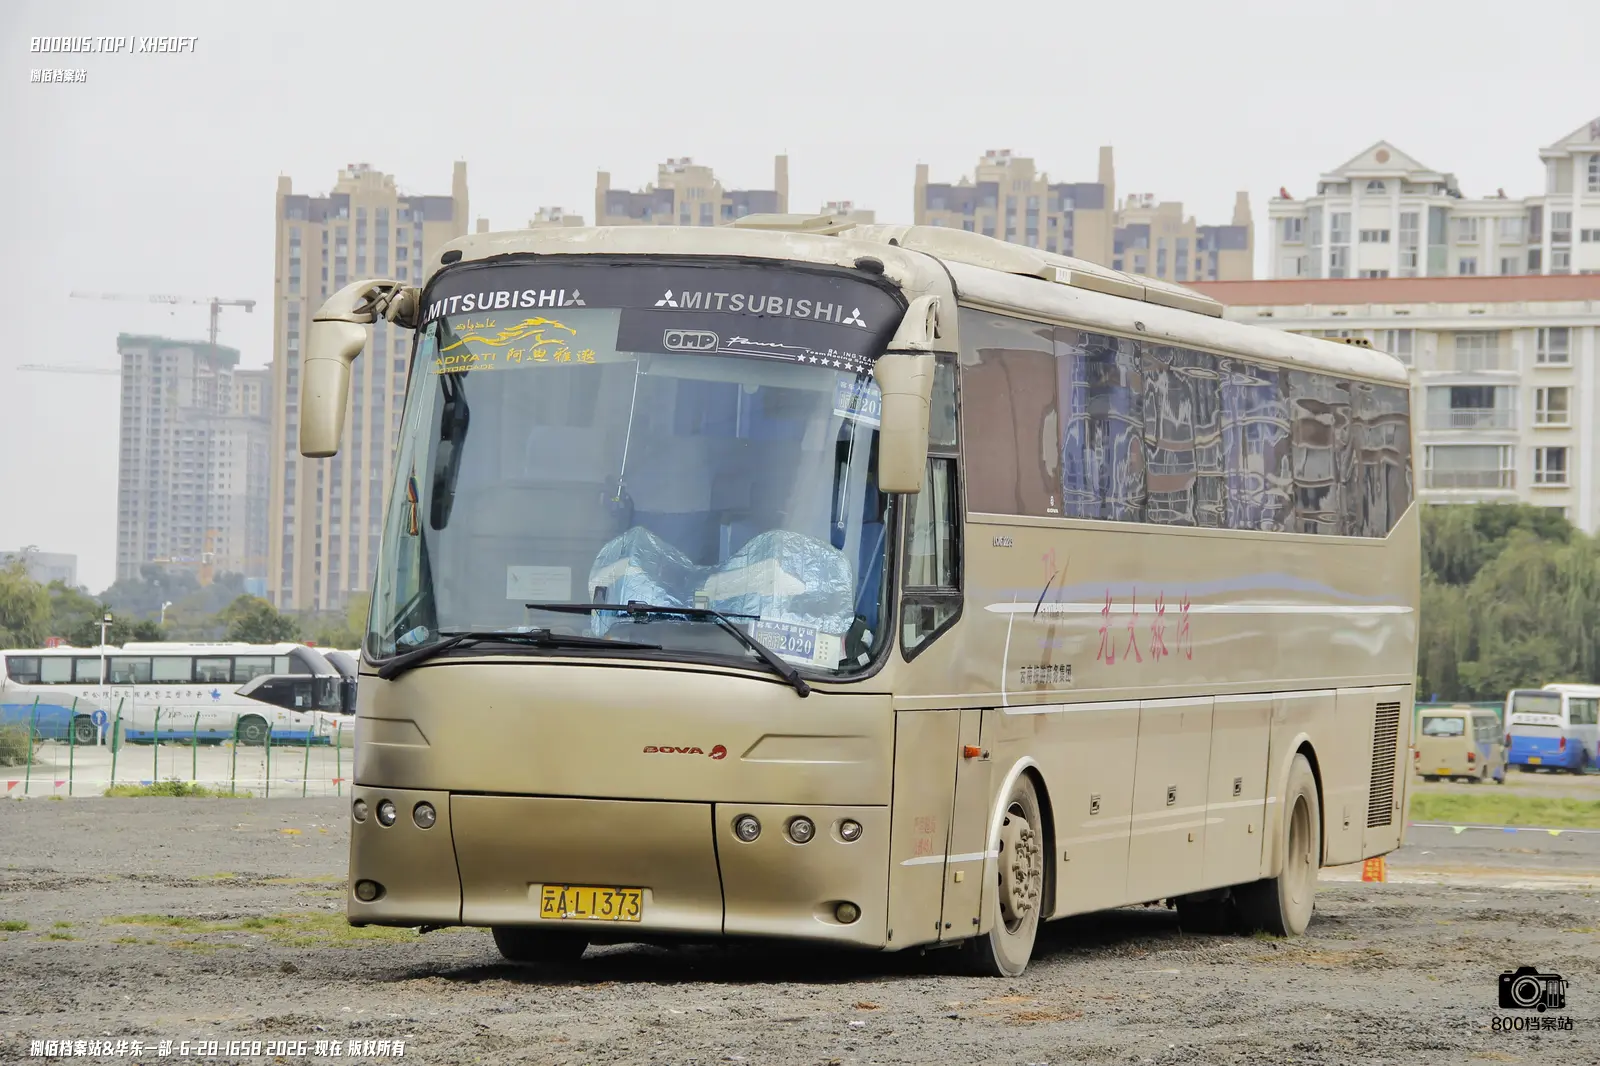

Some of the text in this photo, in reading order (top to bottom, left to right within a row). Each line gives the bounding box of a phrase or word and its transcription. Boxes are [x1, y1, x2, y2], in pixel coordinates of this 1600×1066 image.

[427, 289, 565, 322] MITSUBISHI
[679, 291, 843, 323] MITSUBISHI
[666, 332, 717, 348] OMP
[435, 353, 497, 366] ADIYATI
[779, 635, 812, 655] 2020
[643, 745, 704, 755] BOVA
